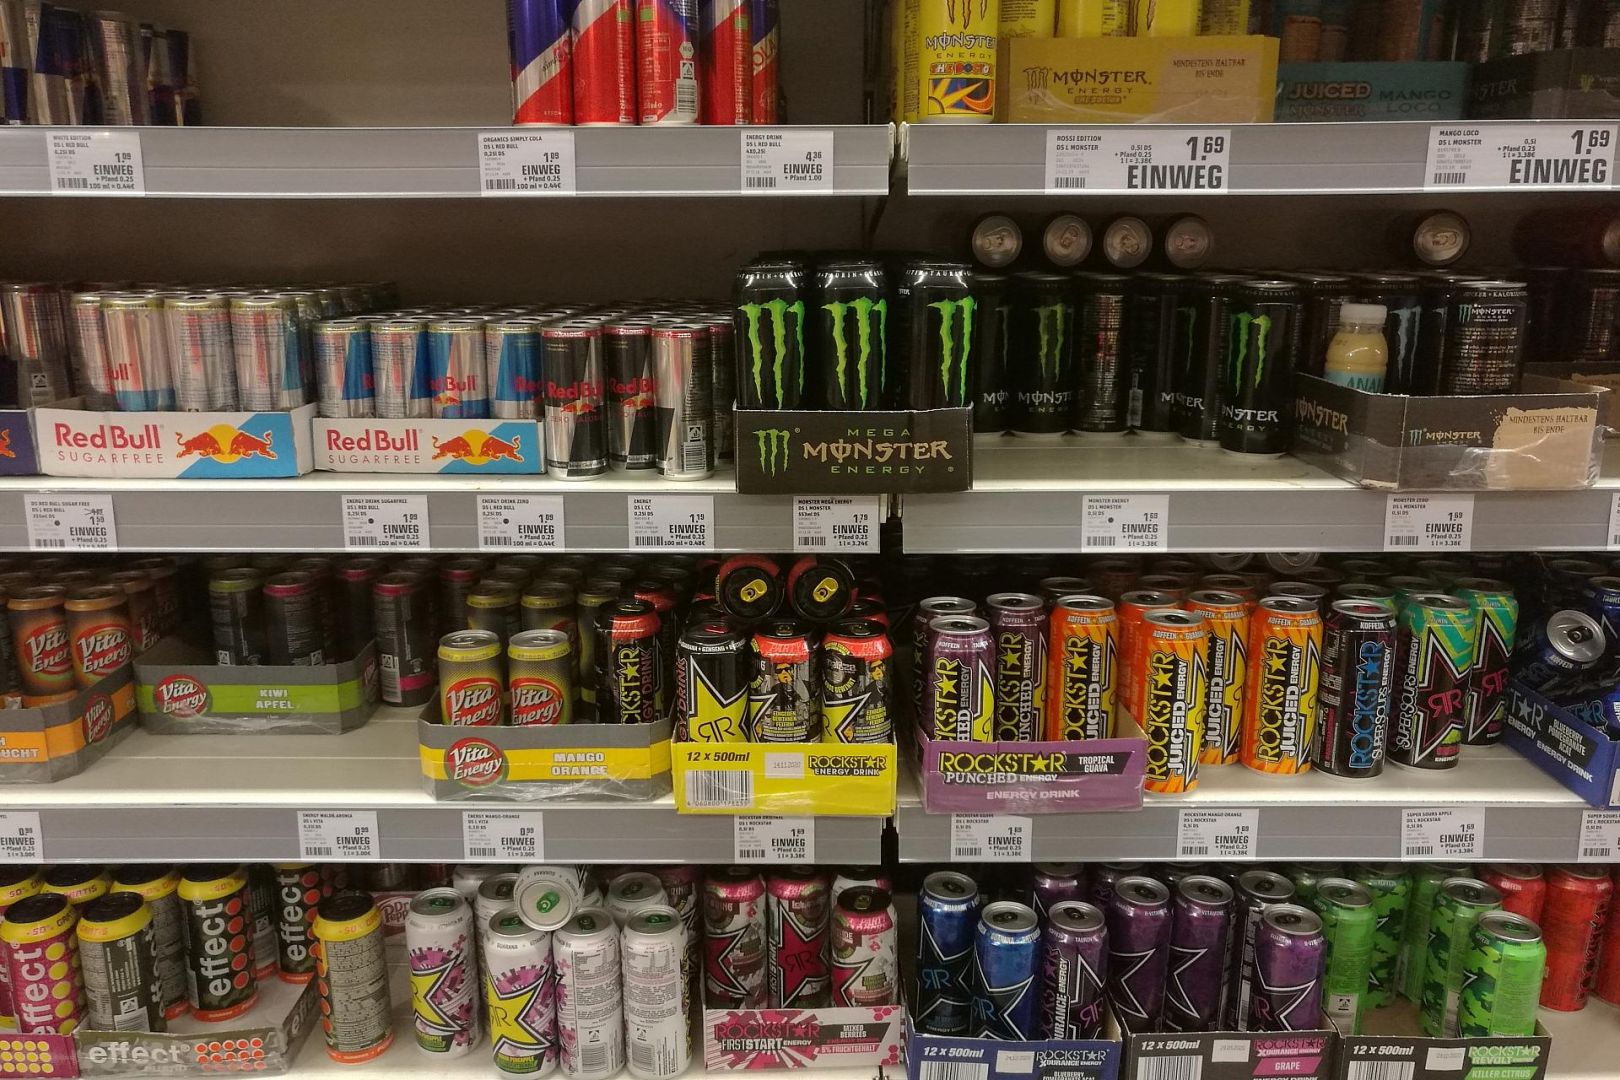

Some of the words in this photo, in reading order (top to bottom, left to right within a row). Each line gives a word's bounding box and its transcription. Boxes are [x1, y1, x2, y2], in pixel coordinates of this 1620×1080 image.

[1053, 69, 1147, 86] MONSTER
[1288, 82, 1370, 99] JUICED
[1380, 90, 1450, 100] MANGO
[1387, 103, 1442, 113] LOCO
[1571, 130, 1610, 154] 1.69
[1186, 136, 1224, 160] 1.69
[94, 165, 133, 175] EINWEG
[522, 165, 560, 175] EINWEG
[784, 164, 822, 174] EINWEG
[1509, 160, 1607, 183] EINWEG
[1128, 165, 1222, 189] EINWEG
[54, 423, 106, 449] Red
[110, 424, 160, 449] Bull
[326, 430, 371, 450] Red
[375, 429, 419, 450] Bull
[1427, 430, 1480, 440] MONSTER
[803, 439, 952, 463] MONSTER
[58, 451, 164, 463] SUGARFREE
[328, 455, 420, 464] SUGARFREE
[70, 528, 106, 536] EINWEG
[383, 525, 419, 533] EINWEG
[518, 525, 554, 533] EINWEG
[670, 525, 705, 533] EINWEG
[833, 525, 868, 533] EINWEG
[1122, 524, 1158, 532] EINWEG
[1426, 524, 1462, 532] EINWEG
[78, 628, 125, 657] Vita
[1092, 644, 1101, 681] ENERGY
[1215, 639, 1225, 676] ENERGY
[1291, 647, 1302, 684] ENERGY
[1177, 662, 1187, 701] ENERGY
[159, 683, 197, 700] Vita
[260, 689, 287, 697] KIWI
[162, 690, 207, 713] Energy
[448, 685, 494, 712] Vita
[1258, 638, 1289, 761] ROCKSTAR
[255, 700, 294, 709] APFEL
[1147, 651, 1174, 781] ROCKSTAR
[1206, 677, 1225, 747] JUICED
[1281, 685, 1299, 756] JUICED
[1168, 702, 1185, 773] JUICED
[450, 747, 493, 766] Vita
[553, 753, 605, 762] MANGO
[687, 752, 699, 762] 12
[714, 752, 750, 762] 500ml
[808, 755, 887, 768] ROCKSTAR
[939, 752, 1067, 772] ROCKSTAR
[1079, 756, 1114, 764] TROPICAL
[453, 756, 503, 779] Energy
[551, 766, 608, 775] ORANGE
[1084, 764, 1108, 772] GUAVA
[1567, 762, 1593, 783] DRINK
[946, 773, 1016, 784] PUNCHED
[1020, 774, 1057, 782] ENERGY
[987, 791, 1037, 800] ENERGY
[988, 837, 1022, 845] EINWEG
[1215, 836, 1248, 844] EINWEG
[1440, 834, 1474, 842] EINWEG
[278, 872, 307, 961] effect
[196, 902, 231, 996] effect
[1142, 1041, 1154, 1050] 12
[1166, 1040, 1200, 1049] 500ml
[1354, 1045, 1367, 1054] 12
[1379, 1045, 1414, 1055] 500ml
[89, 1041, 182, 1065] effect
[924, 1048, 938, 1056] 12
[948, 1047, 984, 1058] 500ml
[1037, 1050, 1107, 1061] ROCKSTAR
[1469, 1045, 1540, 1057] ROCKSTAR
[1275, 1062, 1300, 1070] GRAPE
[1472, 1070, 1499, 1078] KILLER
[1501, 1069, 1530, 1078] CITRUS
